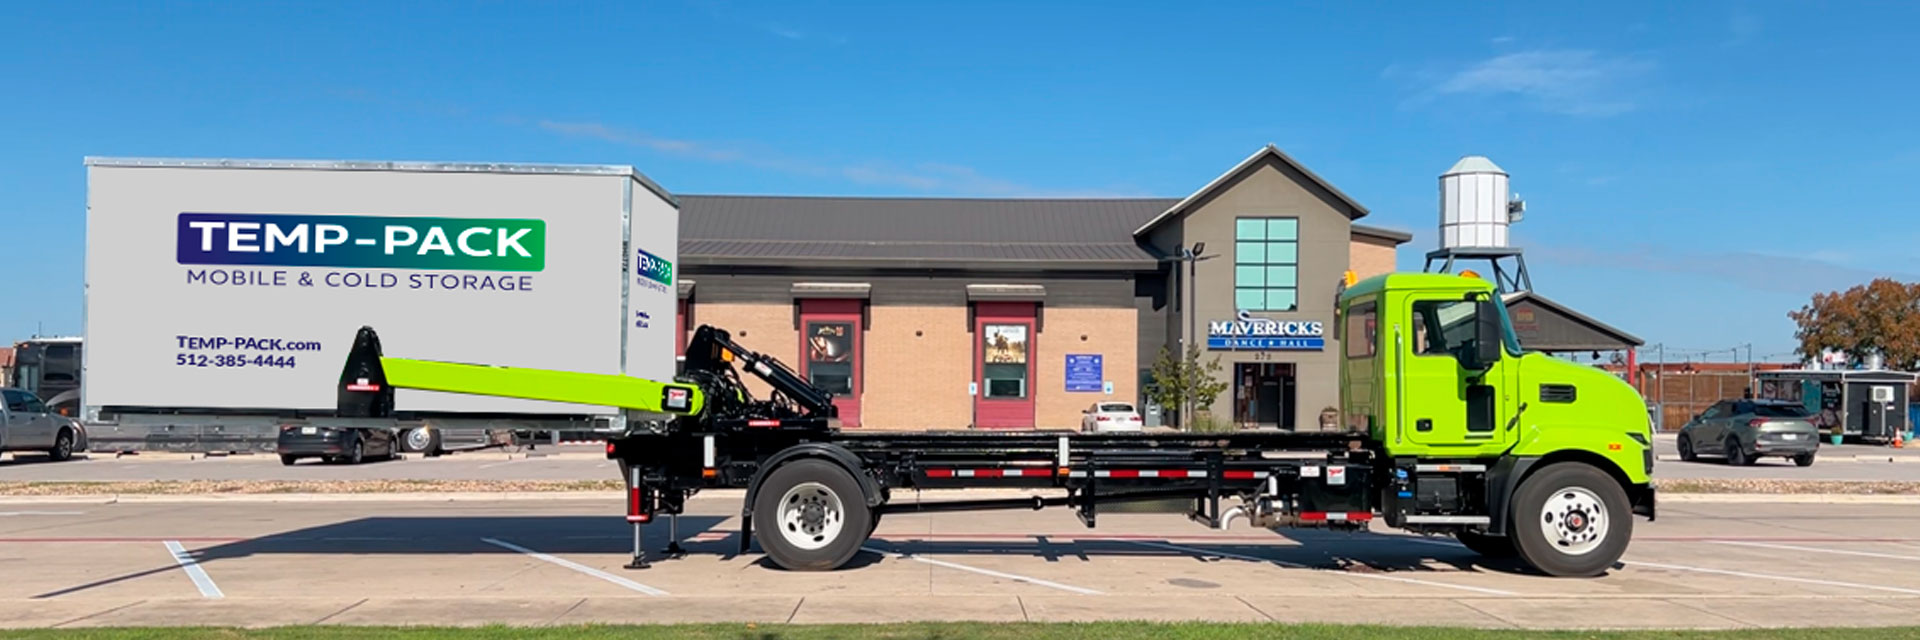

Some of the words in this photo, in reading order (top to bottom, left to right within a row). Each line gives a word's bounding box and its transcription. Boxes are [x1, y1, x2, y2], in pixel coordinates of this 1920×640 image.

[189, 221, 532, 257] TEMP-PACK
[187, 269, 287, 286] MOBILE
[298, 271, 313, 287] &
[325, 272, 398, 288] COLD
[409, 274, 533, 291] STORAGE
[1211, 311, 1324, 336] MAVERICKS
[176, 335, 321, 351] TEMP-PACK.com
[1225, 339, 1263, 347] DANCE
[1279, 339, 1308, 347] HALL
[176, 354, 296, 368] 512-385-4444
